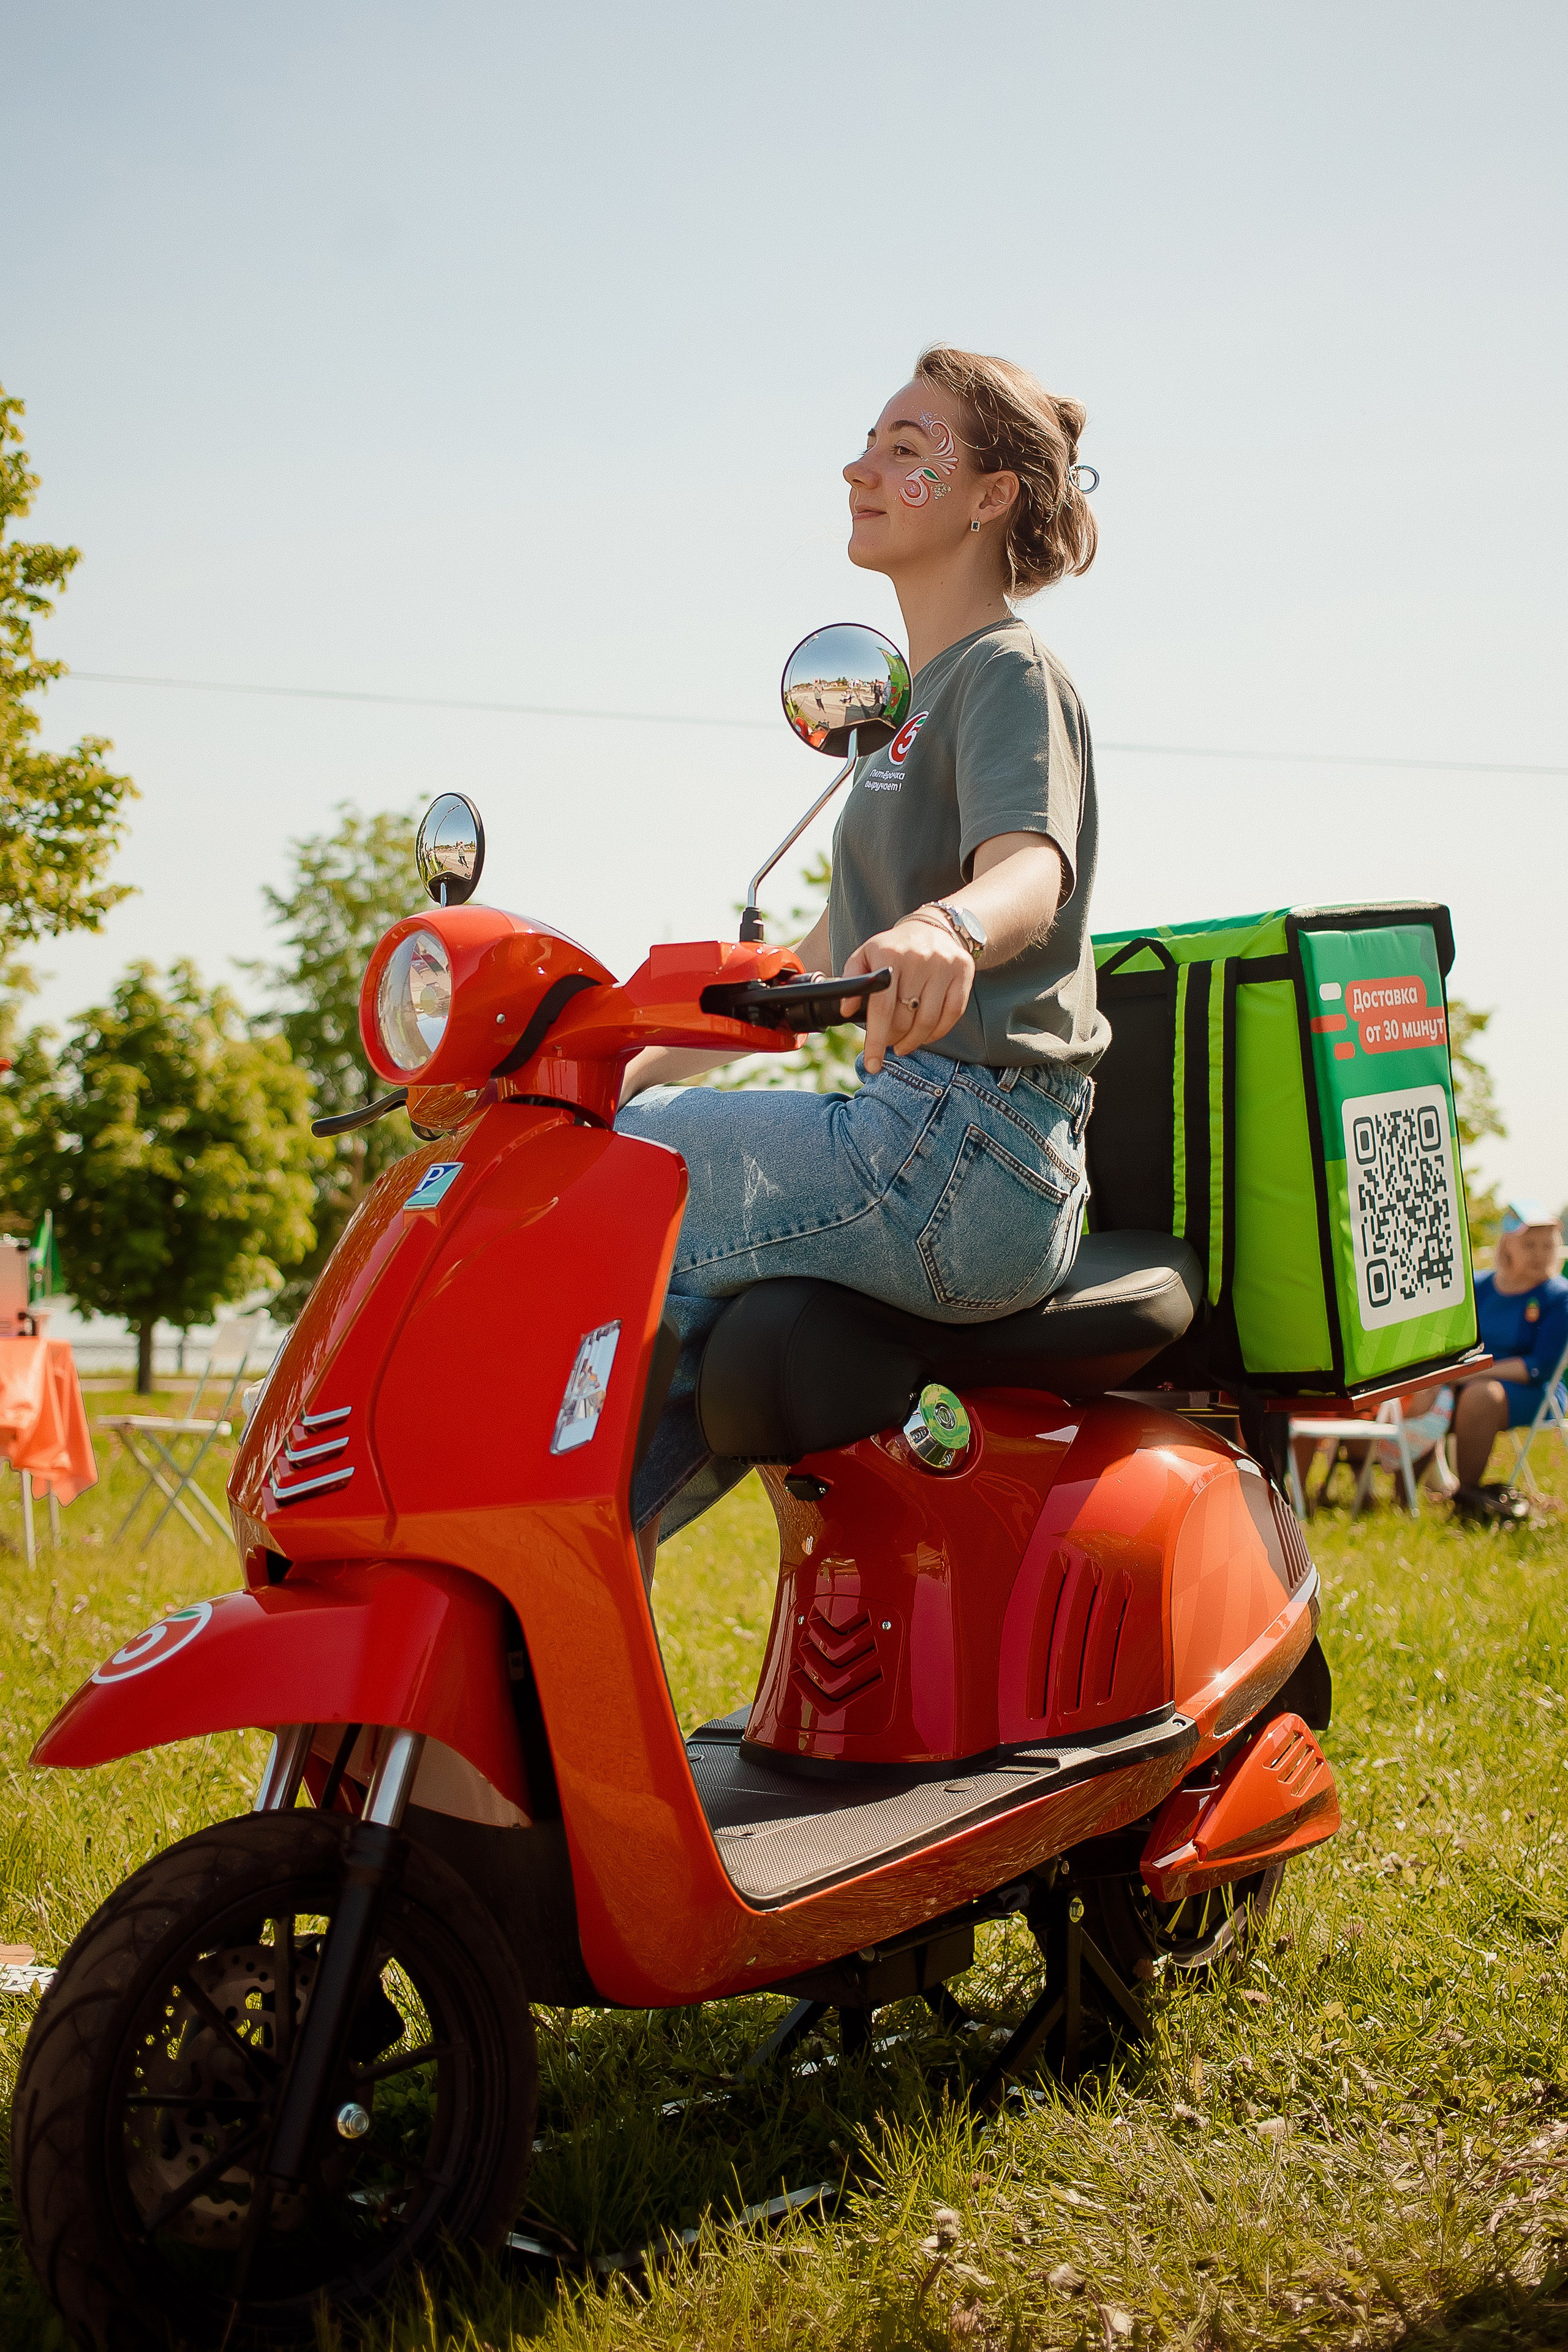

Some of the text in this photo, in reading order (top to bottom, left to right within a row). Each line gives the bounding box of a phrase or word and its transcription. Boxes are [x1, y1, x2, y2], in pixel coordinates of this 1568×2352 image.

[1352, 986, 1419, 1014] Доставка
[1365, 1017, 1444, 1044] от 30 минут
[415, 1166, 445, 1191] P
